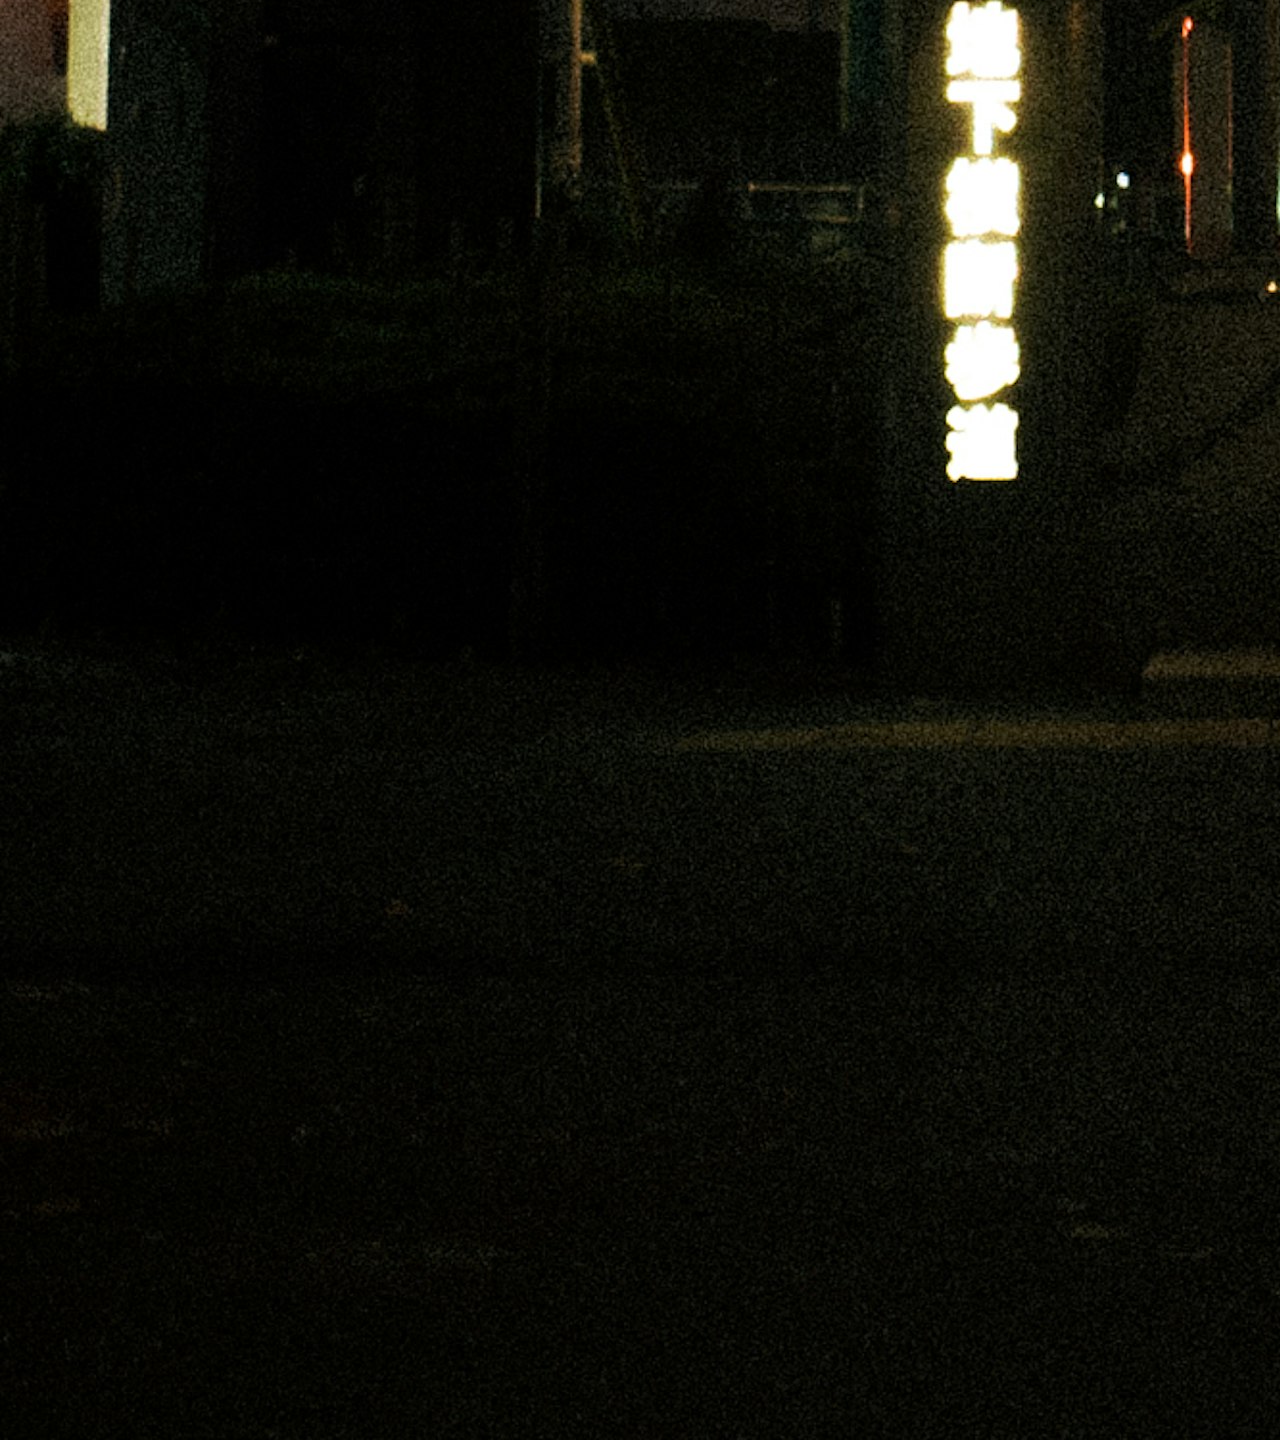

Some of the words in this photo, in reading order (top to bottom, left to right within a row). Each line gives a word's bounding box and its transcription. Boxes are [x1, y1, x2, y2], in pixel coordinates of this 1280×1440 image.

[940, 0, 1023, 482] 地下横断歩道
